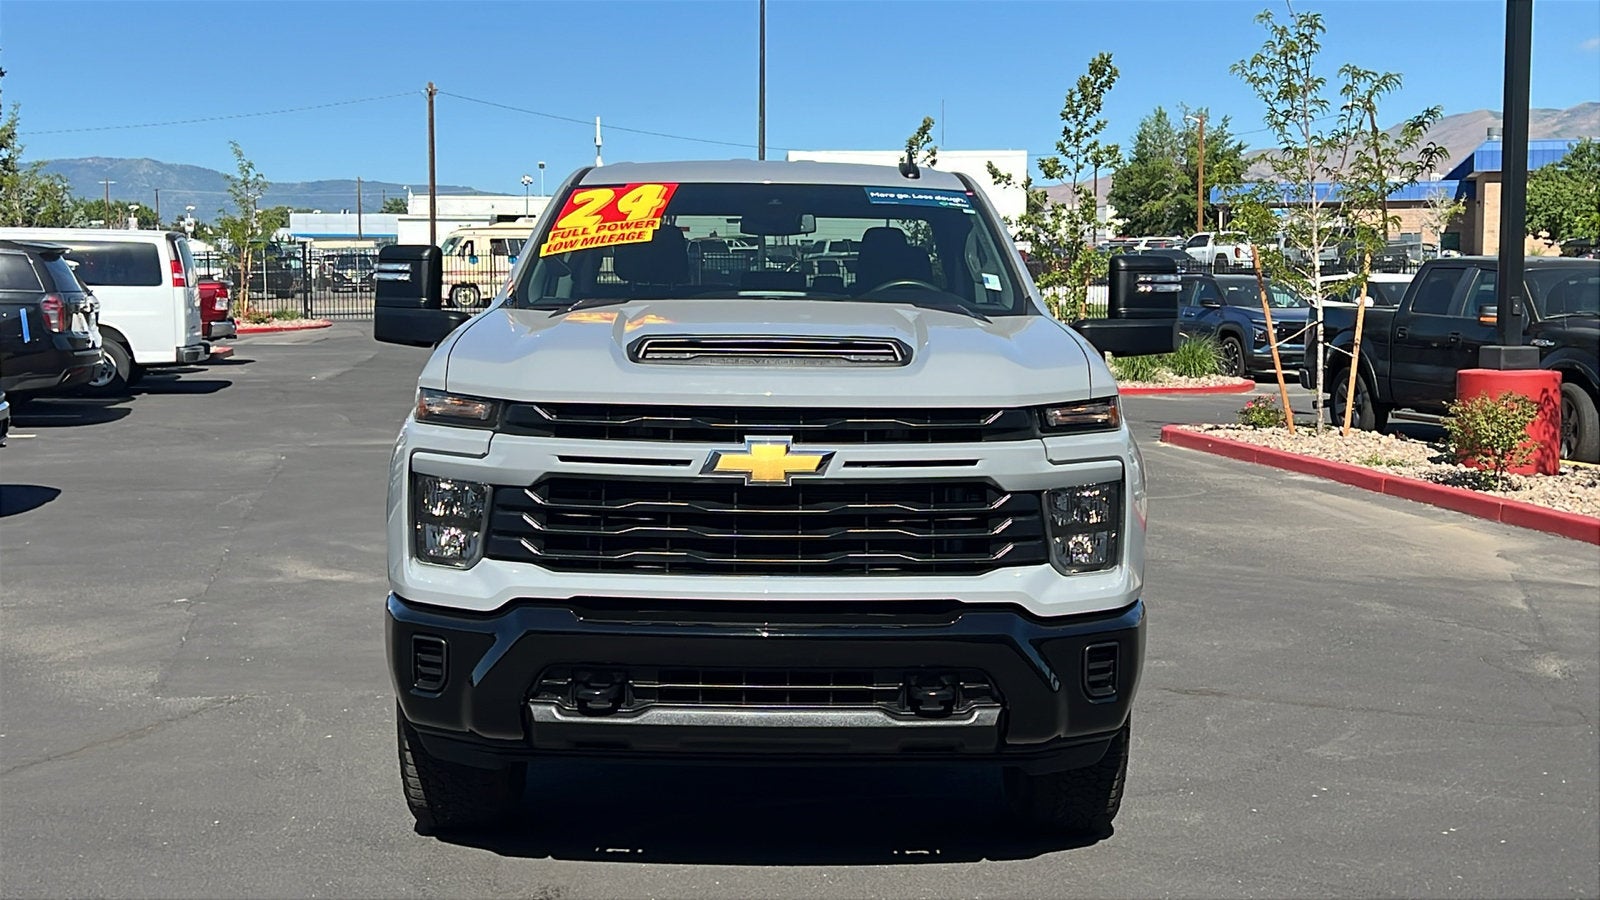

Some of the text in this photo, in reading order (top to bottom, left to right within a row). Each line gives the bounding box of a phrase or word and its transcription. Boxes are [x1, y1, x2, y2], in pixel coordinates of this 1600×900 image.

[557, 184, 667, 229] 24
[551, 219, 657, 241] FULL POWER
[546, 231, 646, 253] LOW MILEAGE
